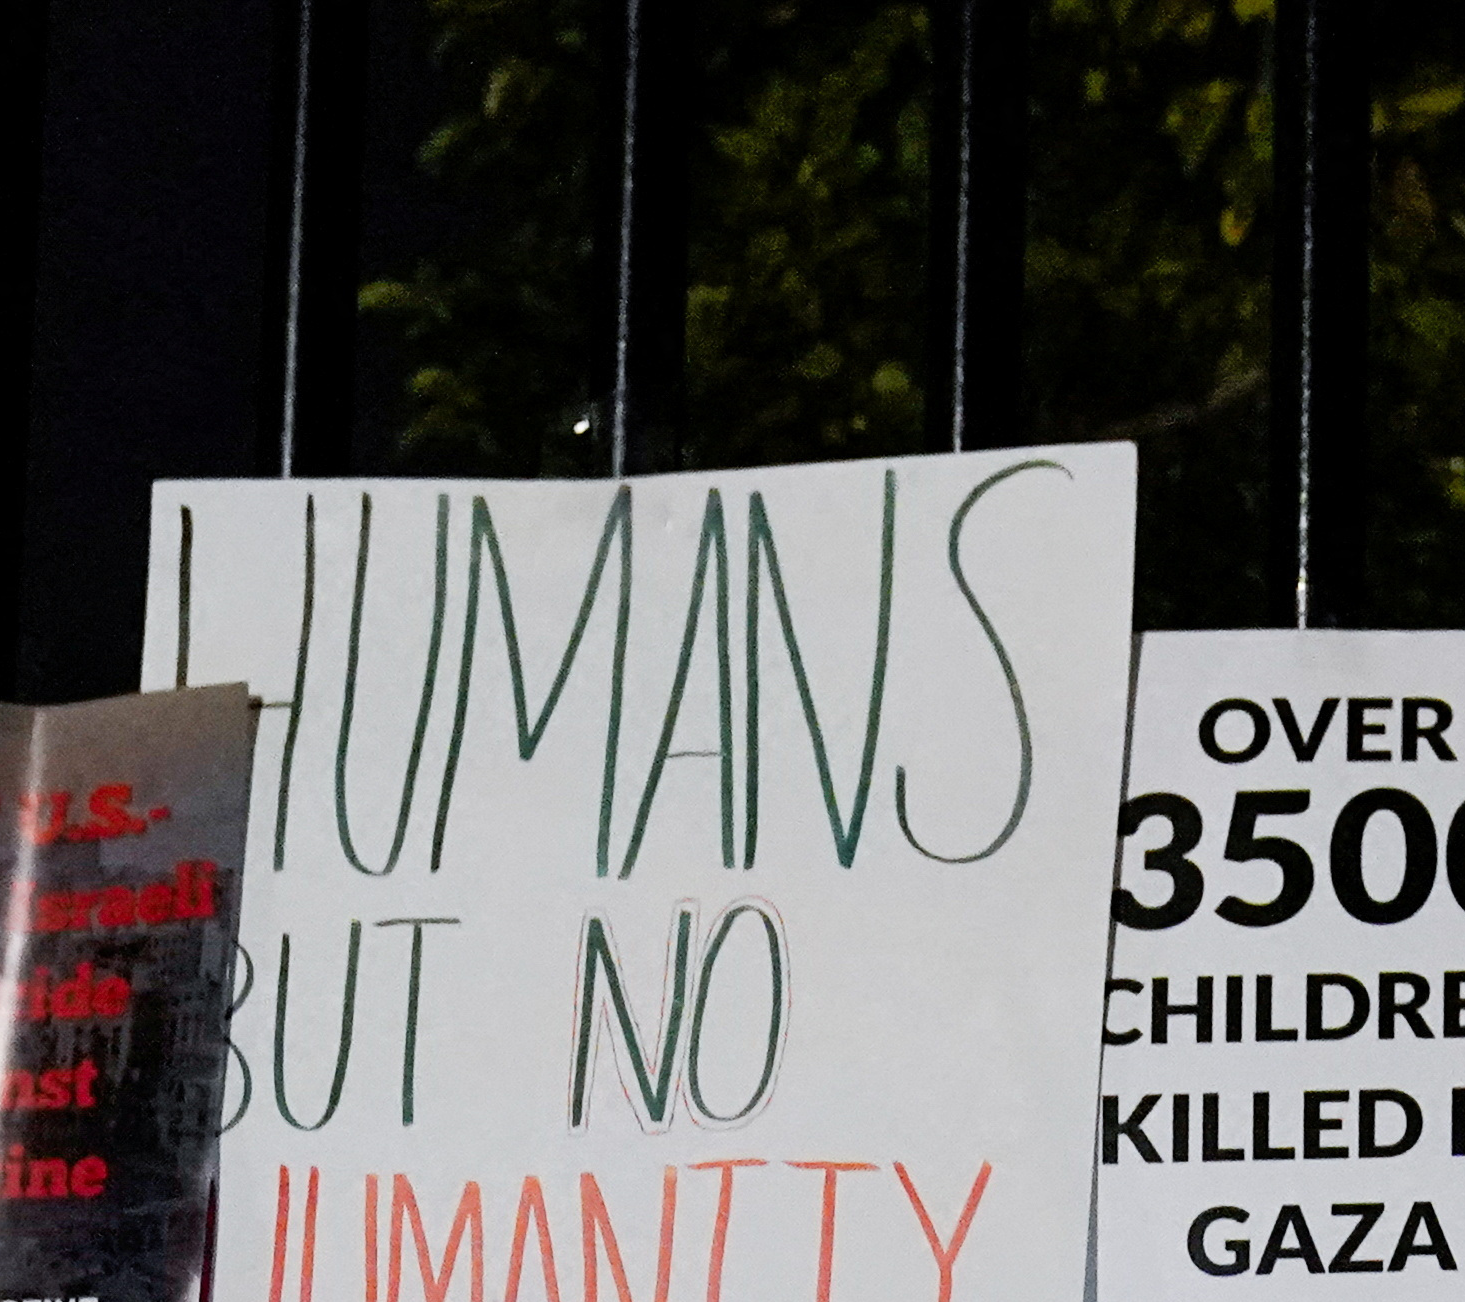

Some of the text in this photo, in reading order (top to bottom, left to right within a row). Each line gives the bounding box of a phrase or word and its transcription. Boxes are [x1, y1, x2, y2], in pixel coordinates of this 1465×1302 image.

[177, 457, 1076, 880] HUMANS
[1196, 696, 1457, 765] OVER
[217, 894, 793, 1136] BUT NO
[1101, 1085, 1425, 1165] KILLED
[1185, 1200, 1458, 1278] GAZA
